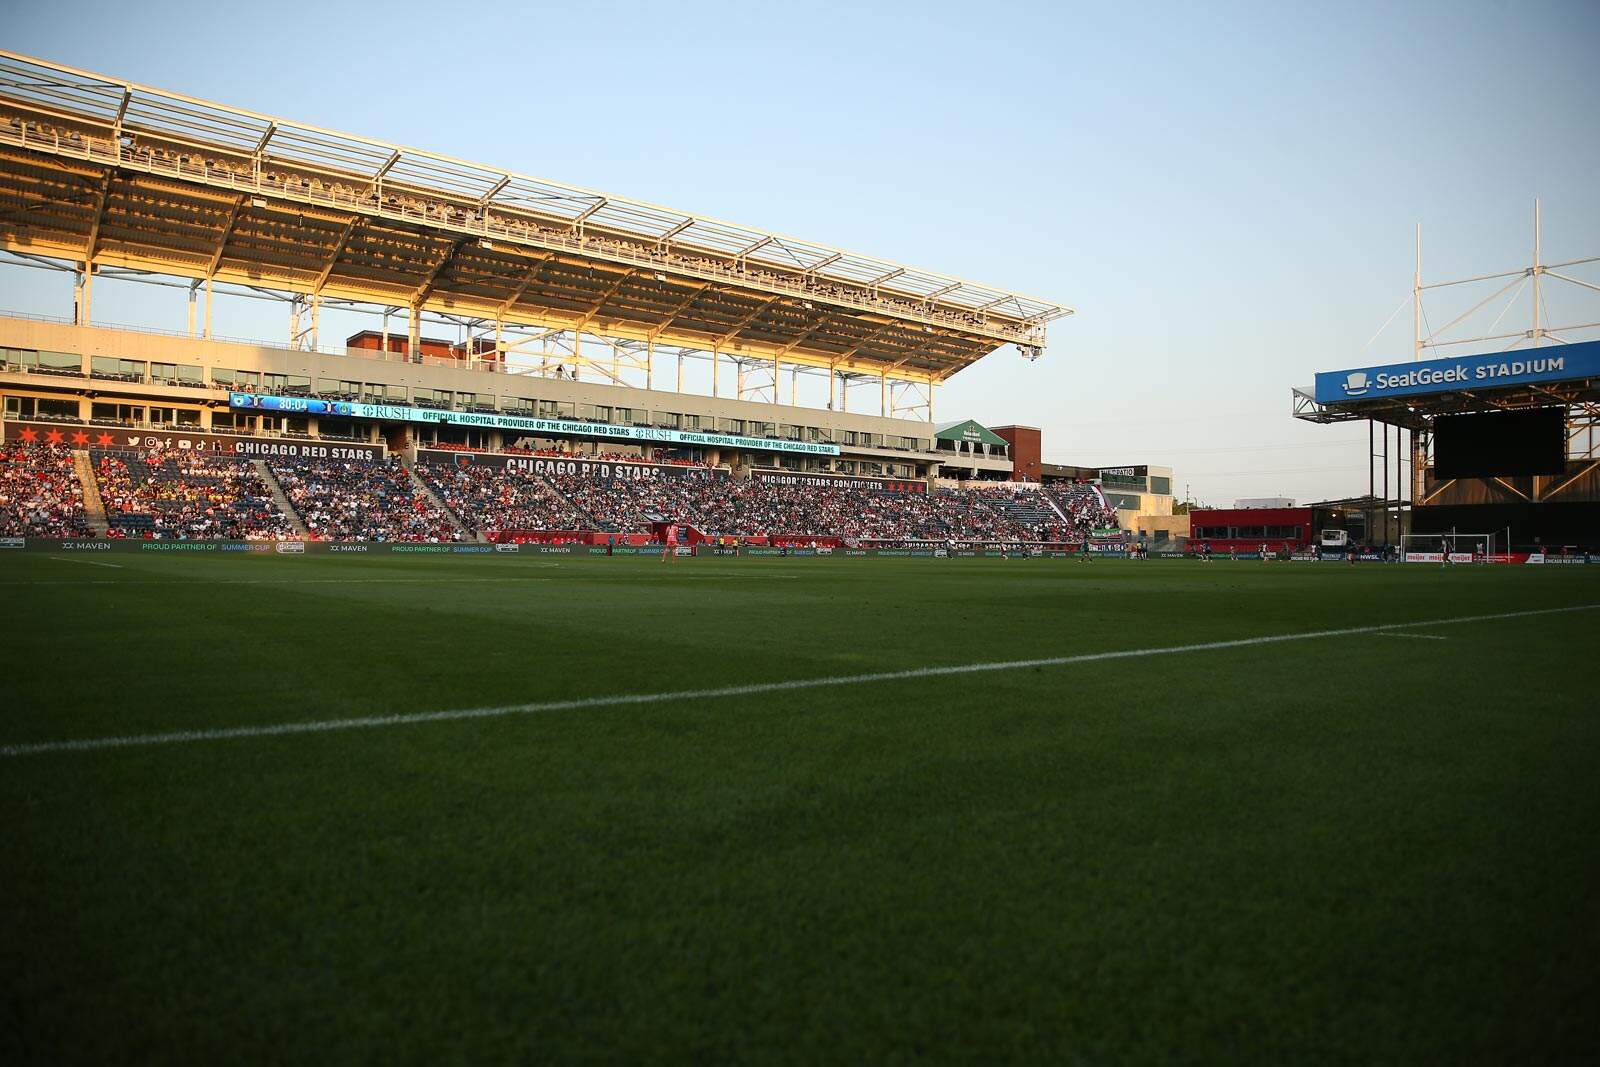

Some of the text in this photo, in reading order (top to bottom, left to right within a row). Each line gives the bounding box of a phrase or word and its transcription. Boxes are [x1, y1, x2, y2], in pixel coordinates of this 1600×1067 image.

[1376, 357, 1564, 389] SeatGeek STADIUM
[279, 399, 308, 410] 30:04
[376, 406, 411, 419] RUSH
[422, 411, 630, 436] OFFICIAL HOSPITAL PROVIDER OF THE CHICAGO RED STARS
[645, 429, 672, 440] RUSH
[679, 433, 706, 443] OFFICIAL
[707, 436, 734, 444] HOSPITAL
[735, 438, 763, 447] PROVIDER
[772, 441, 782, 449] THE
[783, 443, 806, 451] CHICAGO
[818, 445, 834, 453] STARS
[235, 441, 373, 460] CHICAGO RED STARS
[506, 458, 577, 476] CHICAGO
[171, 543, 206, 551] PARTNER
